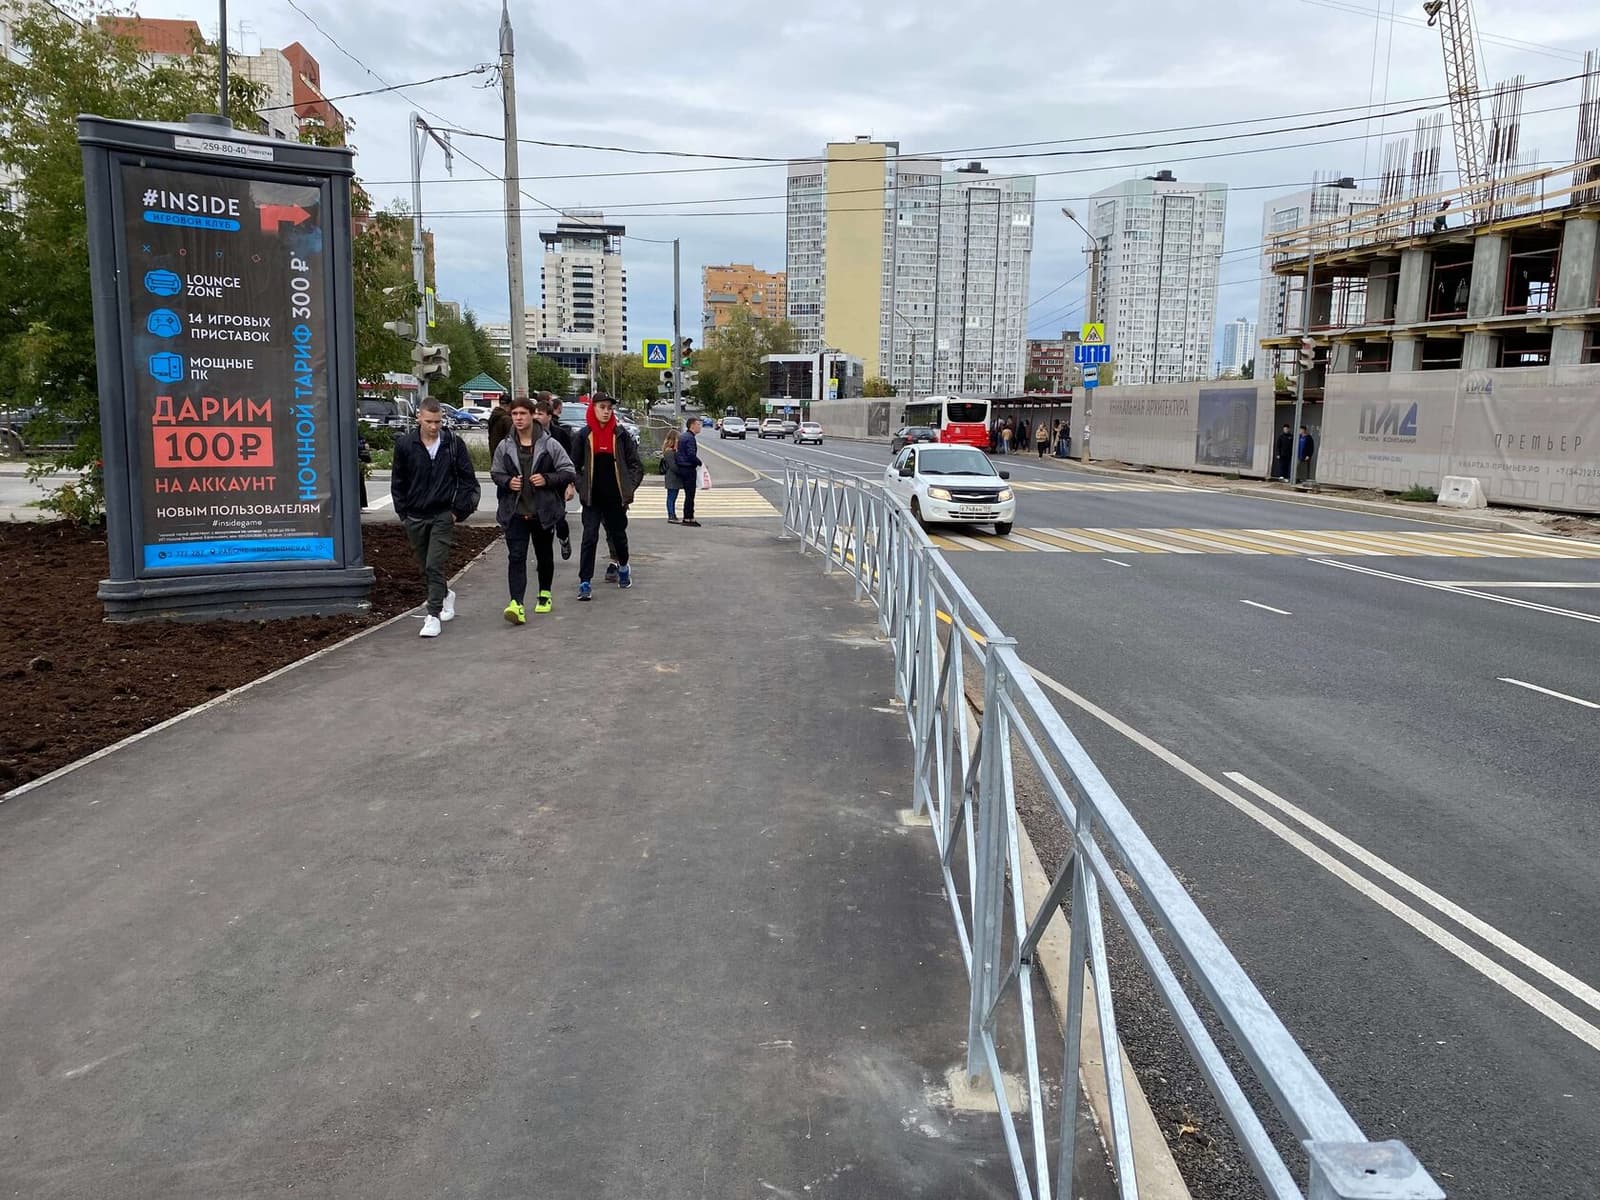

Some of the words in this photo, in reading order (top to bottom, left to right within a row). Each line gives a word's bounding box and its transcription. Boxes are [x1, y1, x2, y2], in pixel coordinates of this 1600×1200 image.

[143, 189, 240, 216] #INSIDE
[152, 213, 202, 226] ИГРОВОЙ
[205, 220, 231, 229] КЛУБ
[187, 274, 241, 288] LOUNGE
[187, 286, 223, 298] ZONE
[291, 277, 311, 319] 300
[188, 313, 203, 324] 14
[208, 314, 271, 327] ИГРОВЫХ
[191, 329, 270, 342] ПРИСТАВОК
[190, 357, 254, 370] МОЩНЫЕ
[292, 324, 313, 398] ТАРИФ
[191, 369, 208, 381] ПК
[152, 396, 272, 425] ДАРИМ
[1494, 433, 1582, 451] ПРЕМЬЕР
[289, 403, 317, 500] НОЧНОЙ
[155, 478, 183, 493] НА
[189, 476, 276, 493] АККАУНТ
[157, 506, 207, 518] НОВЫМ
[210, 503, 321, 516] ПОЛЬЗОВАТЕЛЯМ
[212, 518, 263, 528] #insidegame
